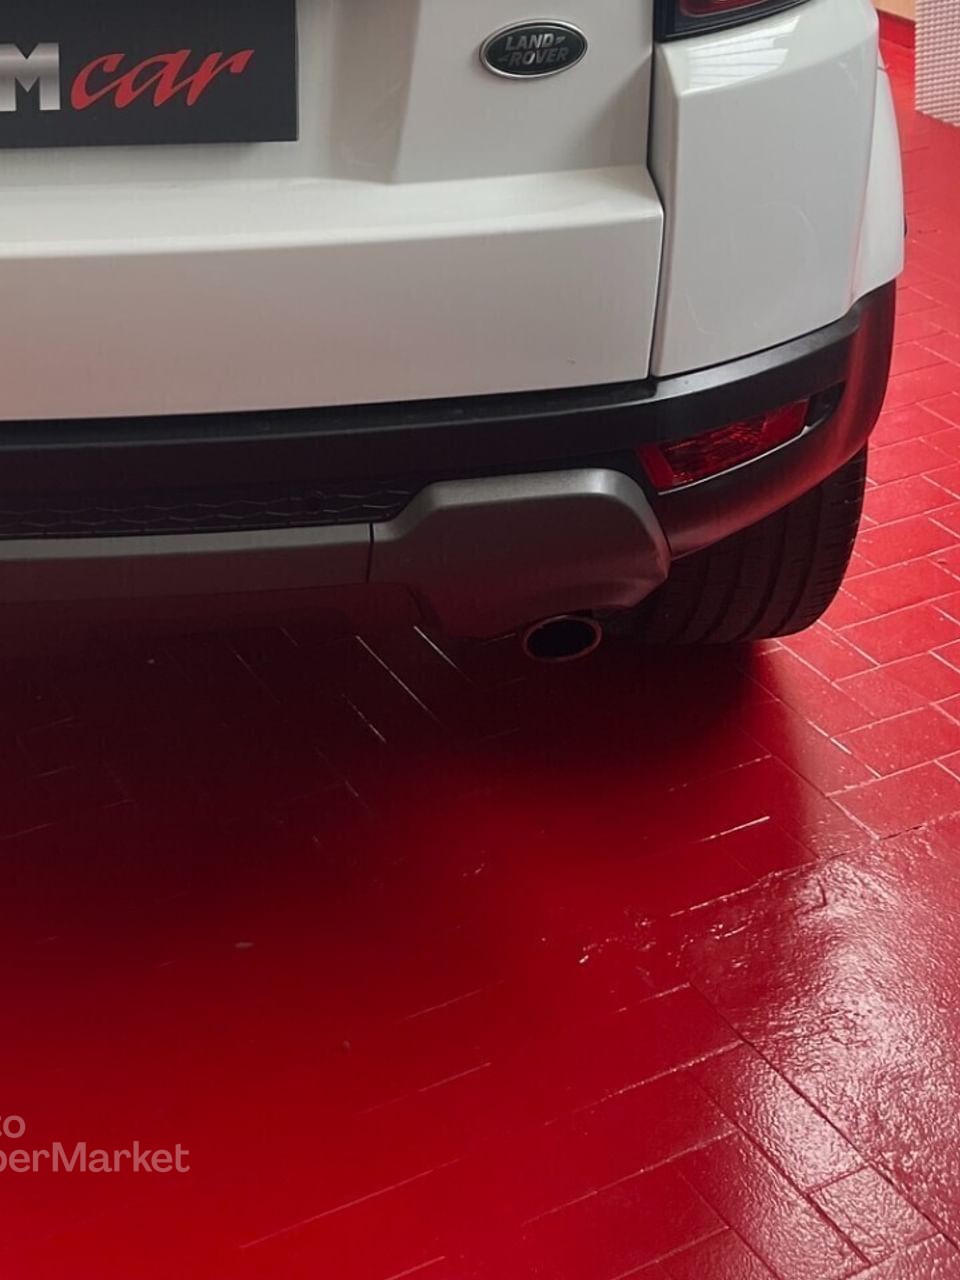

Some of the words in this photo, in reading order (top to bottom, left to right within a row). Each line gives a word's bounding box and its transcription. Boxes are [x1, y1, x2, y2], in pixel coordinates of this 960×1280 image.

[505, 33, 554, 51] LAND
[509, 46, 570, 67] ROVER
[71, 49, 255, 114] car
